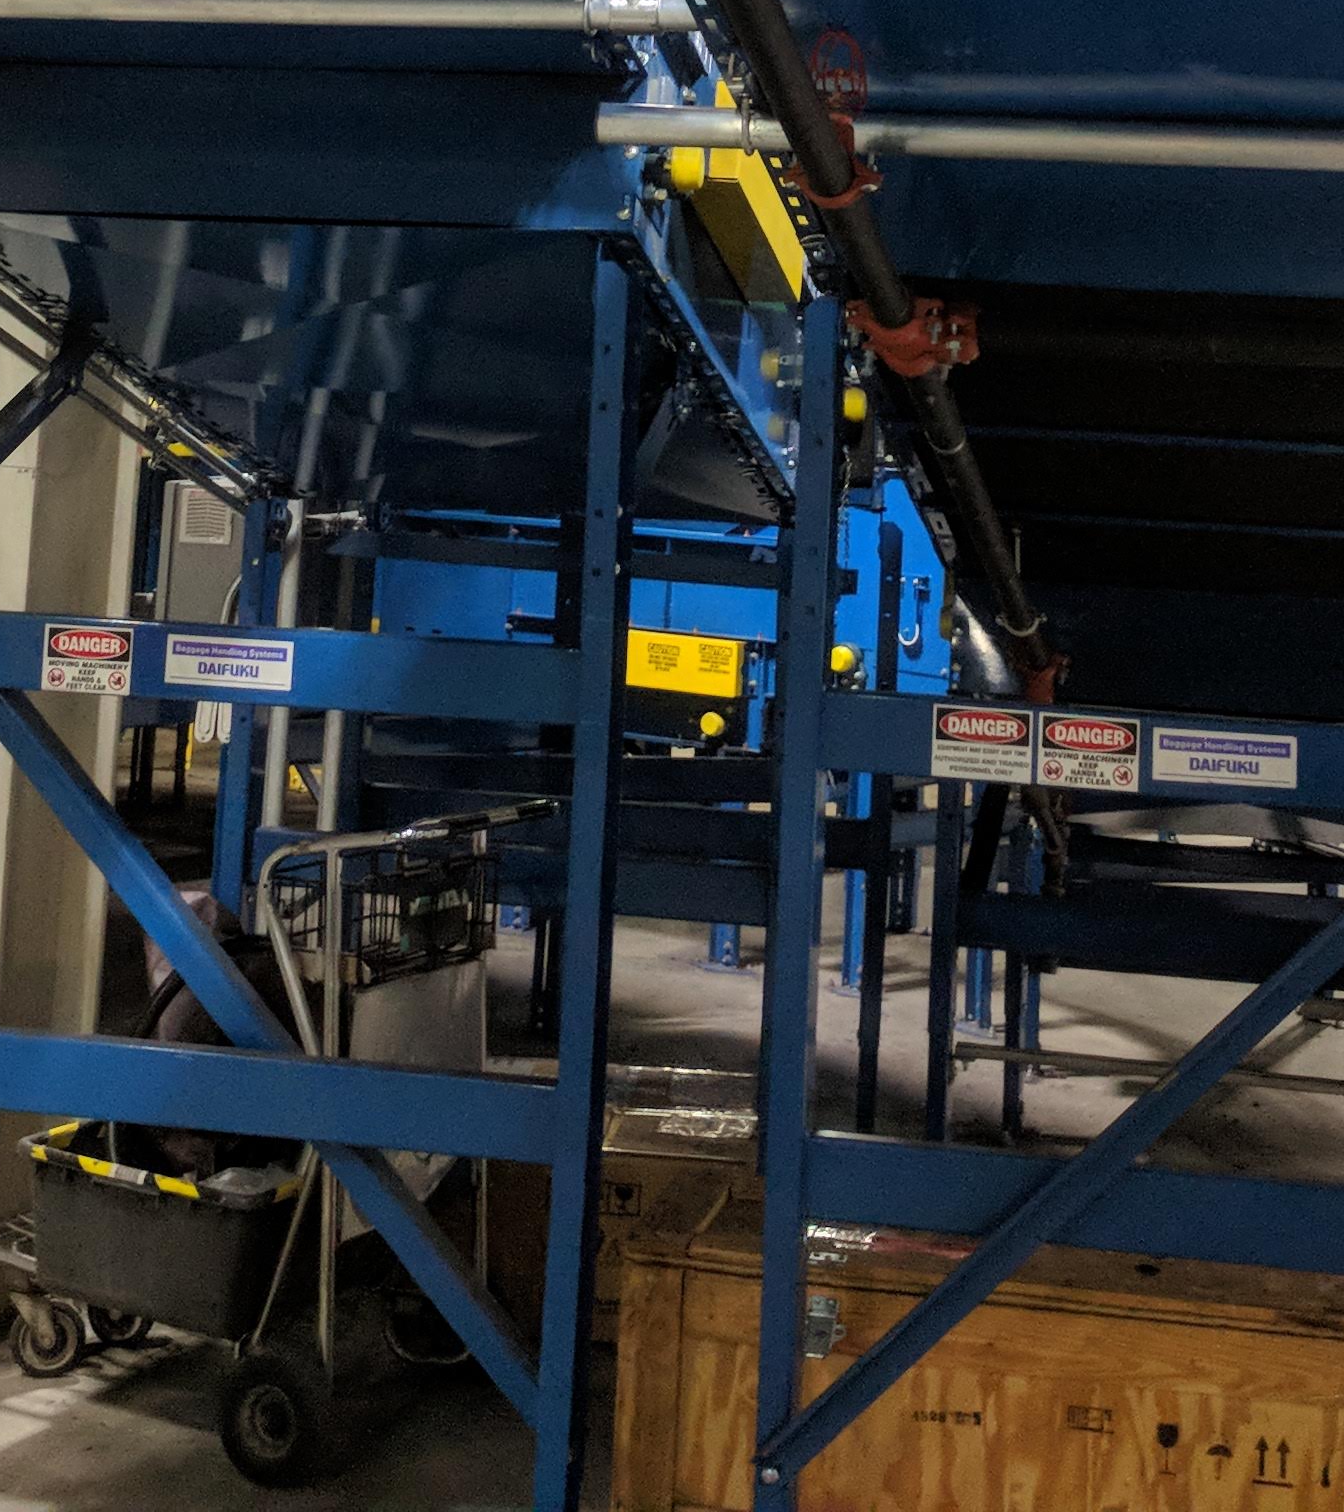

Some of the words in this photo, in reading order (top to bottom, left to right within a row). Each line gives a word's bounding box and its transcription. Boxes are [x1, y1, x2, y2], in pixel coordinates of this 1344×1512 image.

[58, 636, 121, 654] DANGER
[211, 646, 247, 657] Handling
[249, 649, 284, 659] Systems
[82, 662, 128, 670] MACHINERY
[198, 662, 260, 678] DAIFUKU
[948, 716, 1018, 737] DANGER
[1055, 725, 1125, 746] DANGER
[1204, 741, 1245, 753] Handling
[1247, 745, 1287, 755] Systems
[1044, 751, 1079, 760] MOVING
[1082, 754, 1135, 764] MACHINERY
[1189, 757, 1260, 775] DAIFUKU
